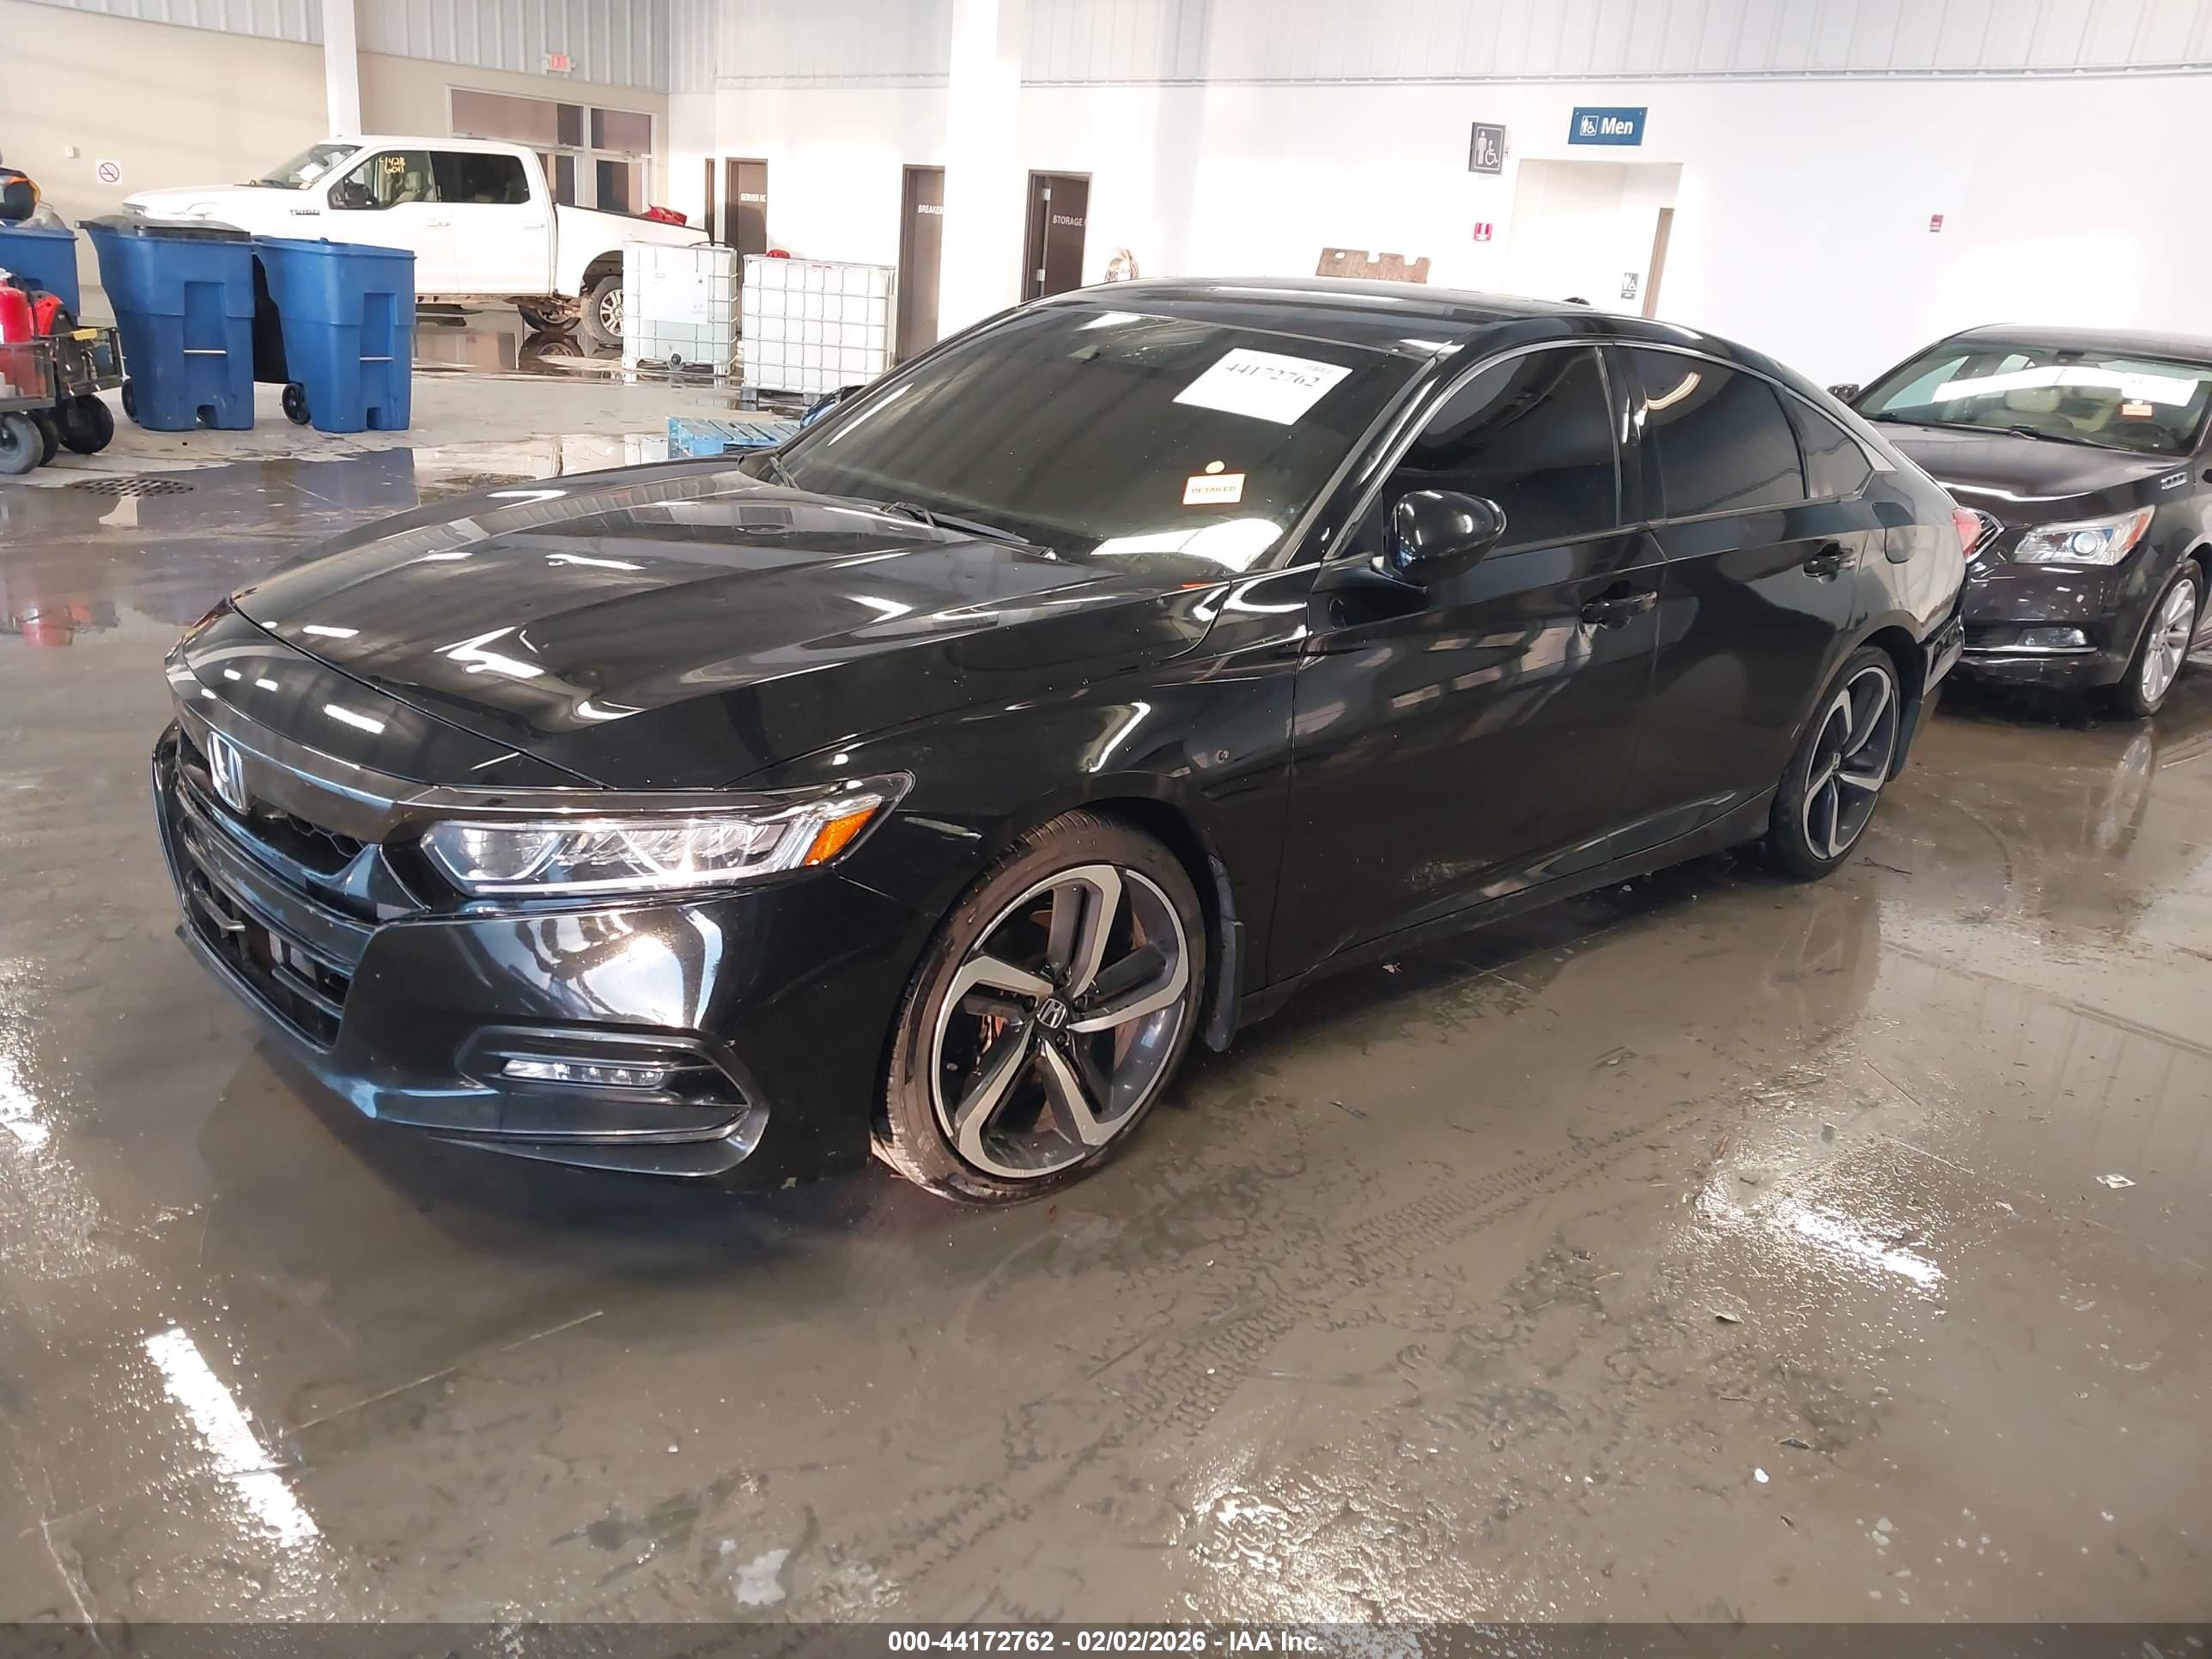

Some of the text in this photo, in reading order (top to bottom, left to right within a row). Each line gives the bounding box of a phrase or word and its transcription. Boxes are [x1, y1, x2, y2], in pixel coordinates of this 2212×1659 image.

[1601, 117, 1633, 135] Men
[1053, 214, 1084, 227] STORAGE
[1225, 362, 1321, 387] 44172762
